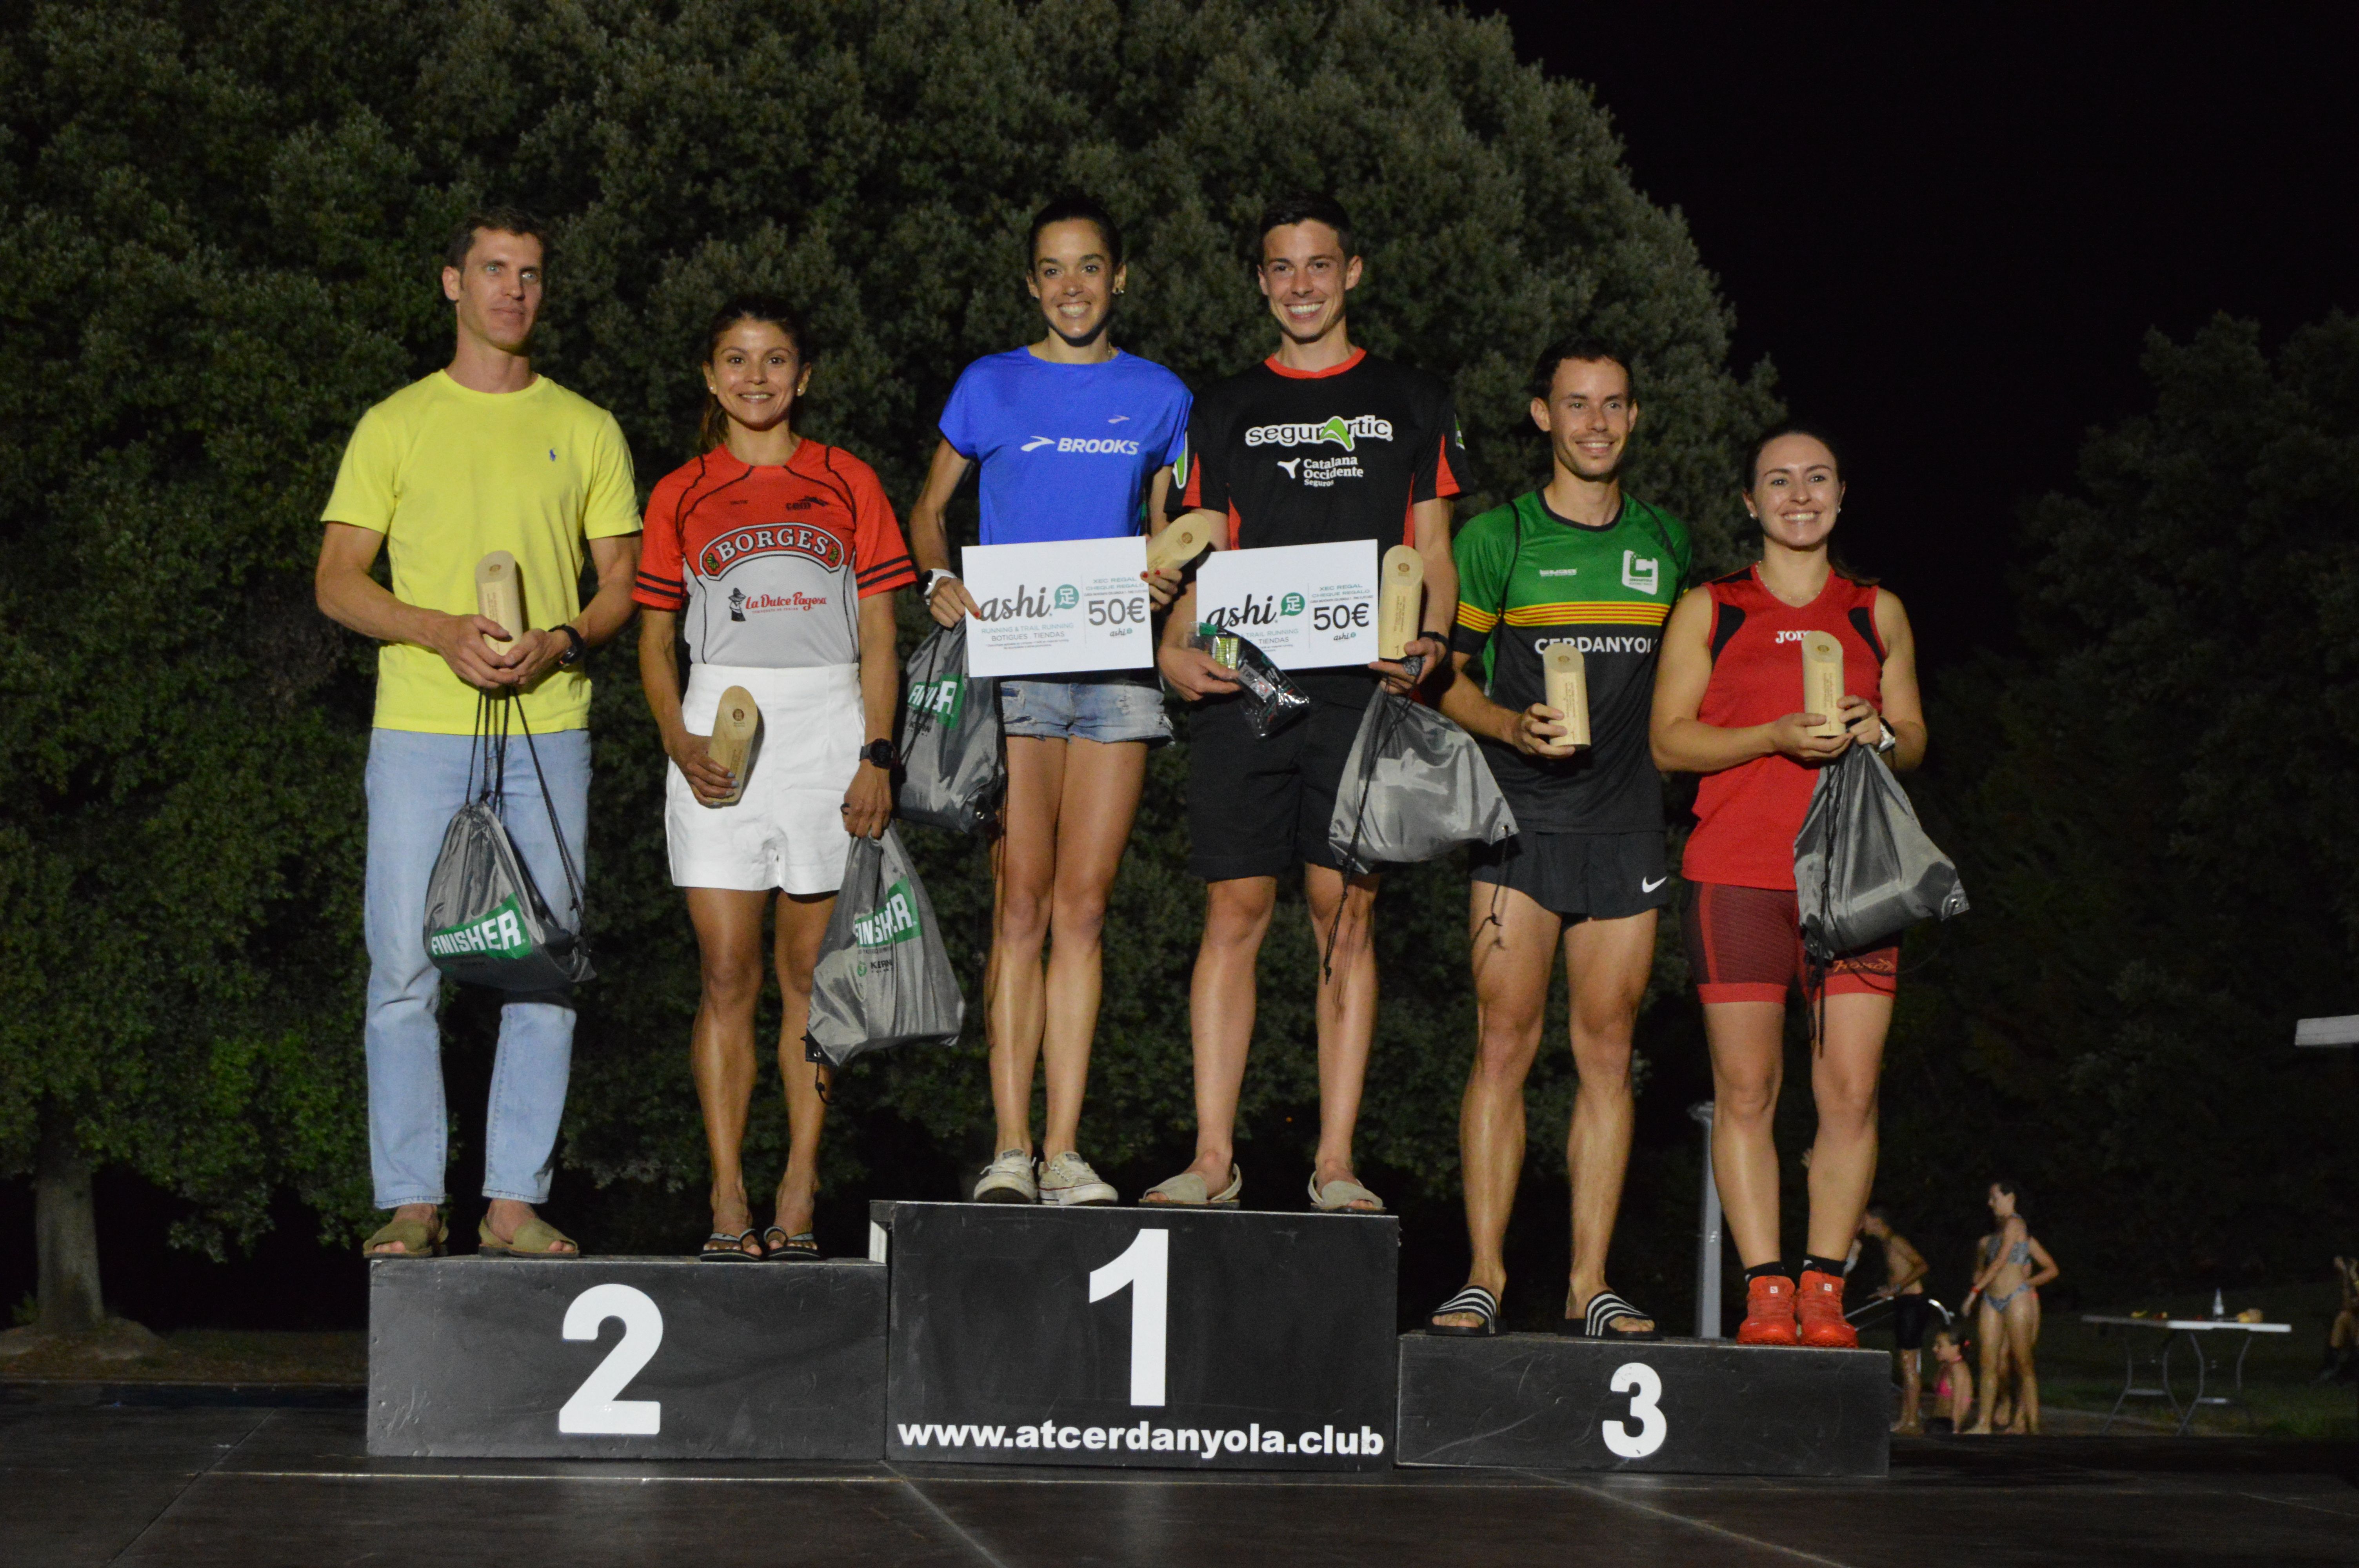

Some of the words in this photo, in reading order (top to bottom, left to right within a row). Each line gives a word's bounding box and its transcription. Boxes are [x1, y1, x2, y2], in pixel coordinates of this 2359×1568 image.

[1057, 437, 1139, 455] BROOKS
[1303, 456, 1358, 469] Catalana
[1303, 466, 1364, 479] Occidente
[715, 528, 829, 563] BORGES
[746, 596, 759, 609] La
[761, 594, 792, 608] Dulce
[793, 592, 827, 611] Pagesa
[980, 584, 1050, 622] ashi
[1089, 597, 1145, 626] 50€
[1206, 593, 1277, 628] ashi
[1313, 603, 1370, 631] 50€
[992, 633, 1028, 642] BOTIGUES
[1110, 628, 1126, 637] ashi
[1333, 632, 1350, 641] ashi
[432, 909, 522, 955] FINISHER
[1089, 1228, 1169, 1406] 1
[559, 1283, 663, 1435] 2
[1602, 1362, 1667, 1458] 3
[897, 1419, 1384, 1459] www.atcerdanyola.club
